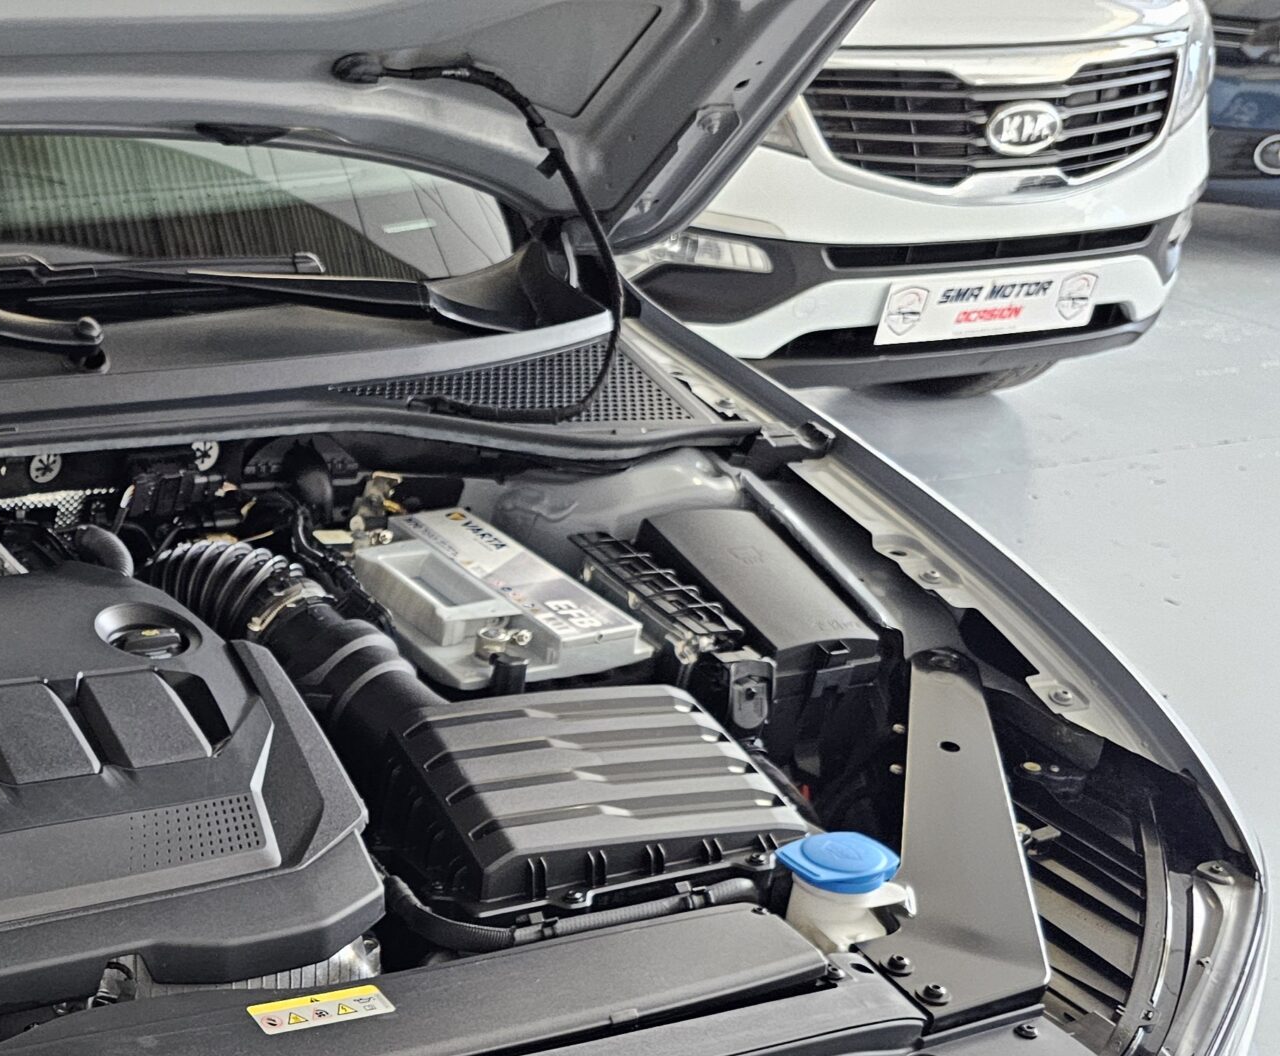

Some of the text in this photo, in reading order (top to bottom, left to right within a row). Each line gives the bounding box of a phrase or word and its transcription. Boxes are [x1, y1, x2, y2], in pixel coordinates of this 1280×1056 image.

[1001, 114, 1051, 142] KIA
[938, 280, 1054, 304] SMA MOTOR
[461, 521, 507, 550] VARTA
[544, 599, 602, 628] EFB
